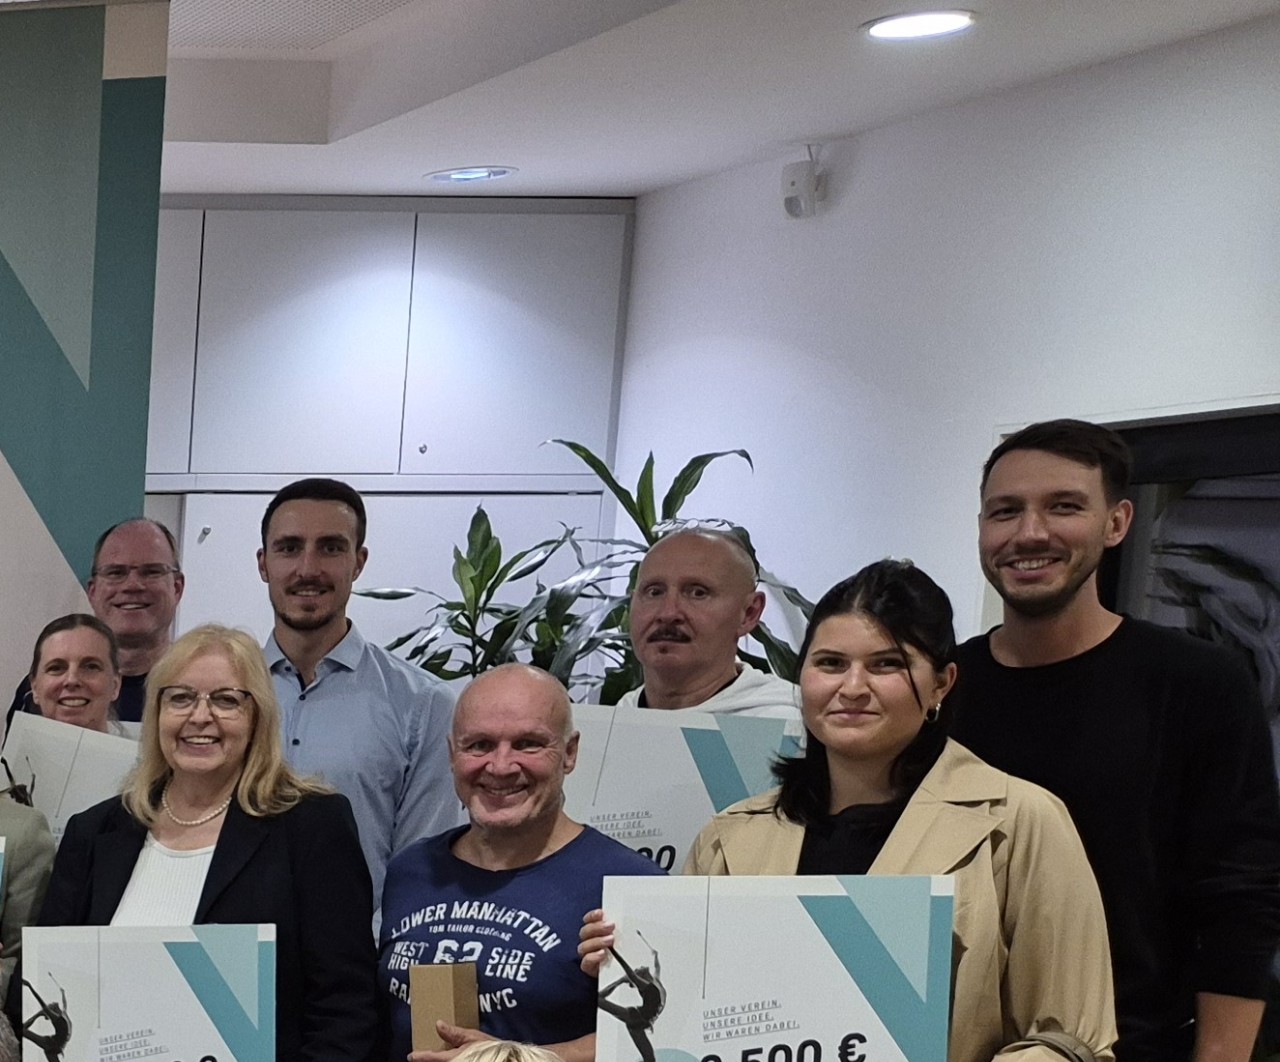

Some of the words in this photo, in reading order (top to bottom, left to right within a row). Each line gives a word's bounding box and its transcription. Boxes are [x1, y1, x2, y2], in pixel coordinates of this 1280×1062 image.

[390, 903, 448, 940] LOWER
[449, 899, 563, 953] MANHATTAN
[392, 940, 430, 959] WEST
[484, 963, 532, 983] LINE
[478, 988, 519, 1014] NYC
[702, 1006, 735, 1018] UNSER
[702, 1017, 742, 1029] UNSERE
[702, 1032, 720, 1041] WIR
[725, 1026, 760, 1037] WAREN
